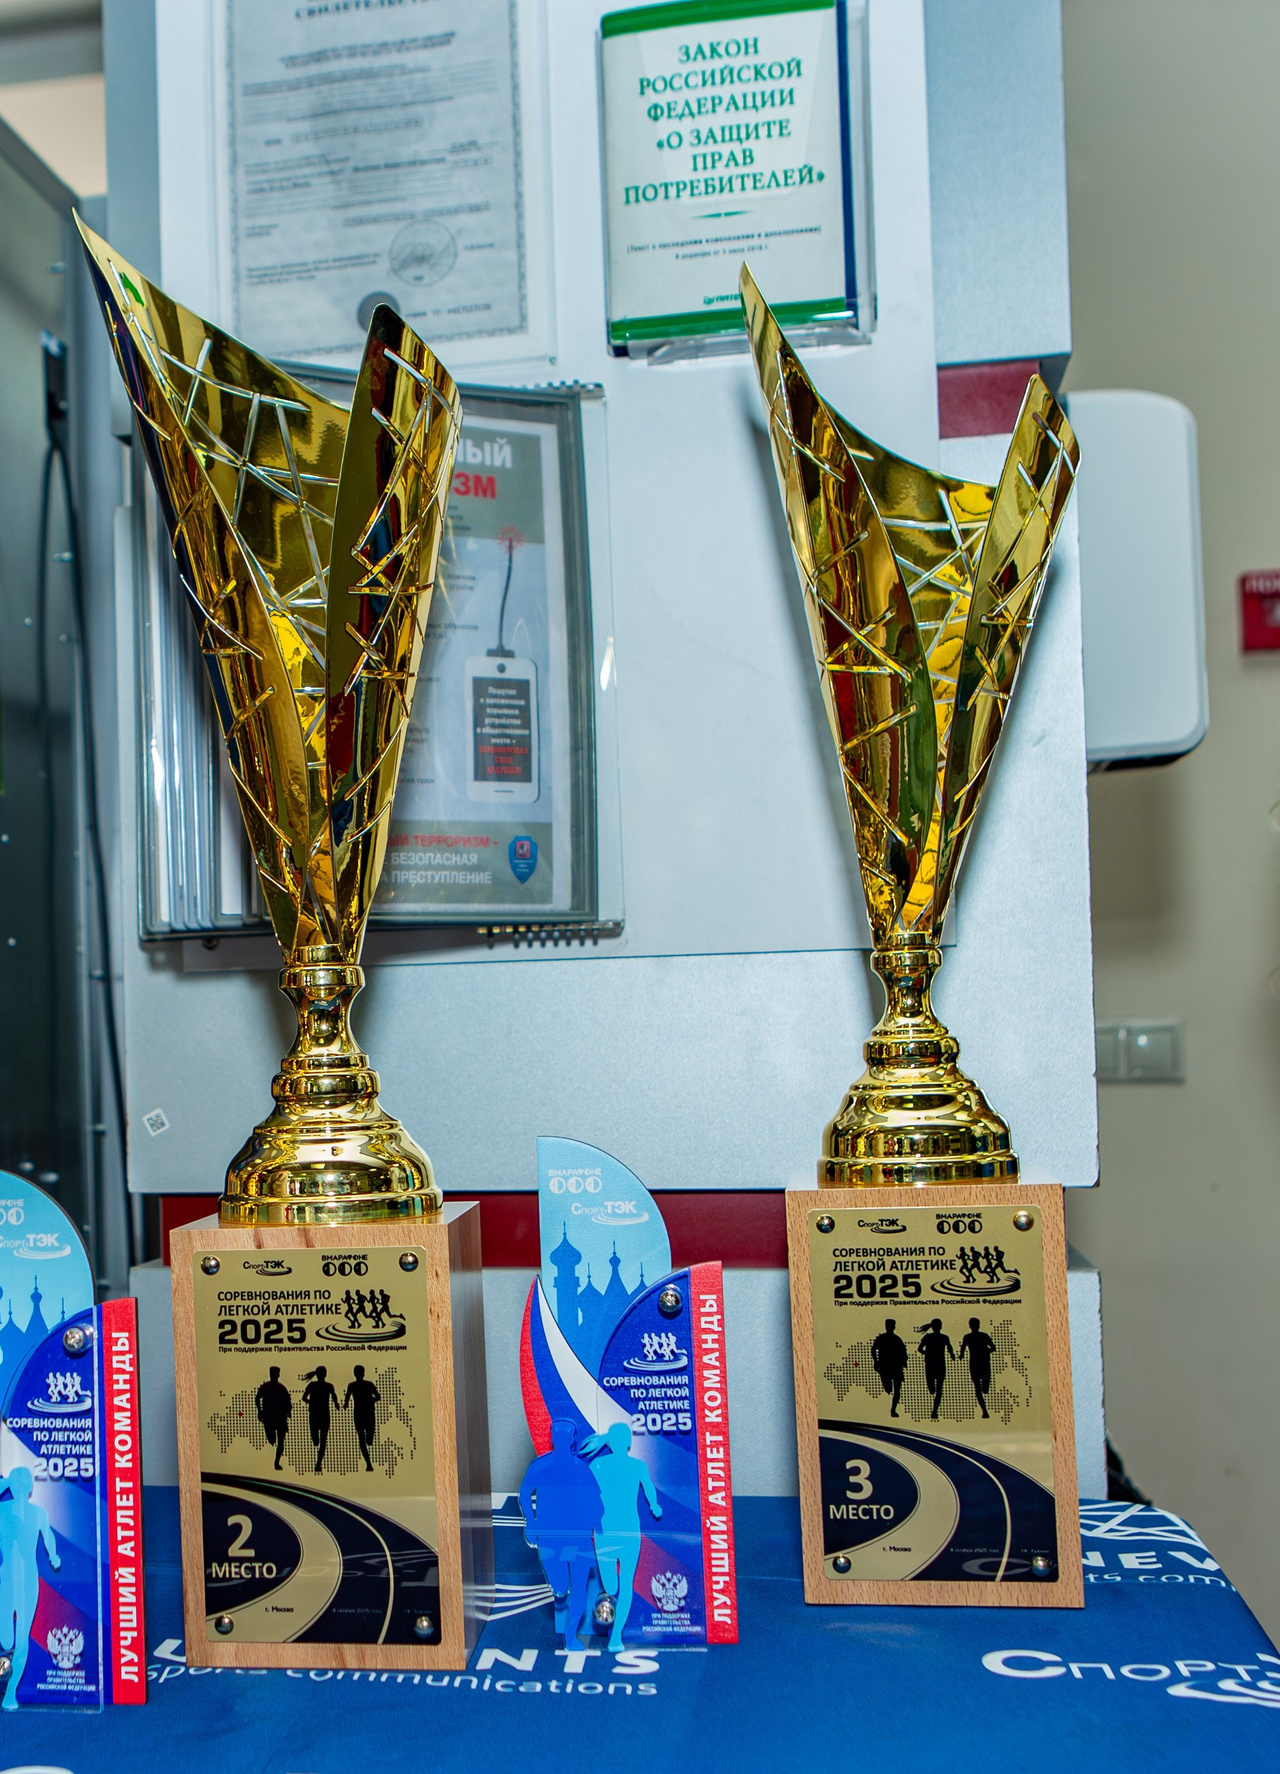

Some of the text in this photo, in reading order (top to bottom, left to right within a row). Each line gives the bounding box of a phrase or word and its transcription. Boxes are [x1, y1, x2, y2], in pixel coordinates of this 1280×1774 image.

[678, 36, 759, 63] ЗАКОН
[639, 57, 802, 96] РОССИЙСКОЙ
[647, 87, 795, 121] ФЕДЕРАЦИИ
[656, 118, 792, 150] «О ЗАЩИТЕ
[692, 148, 755, 172] ПРАВ
[623, 164, 825, 205] ПОТРЕБИТЕЛЕЙ»
[451, 471, 497, 500] ЗМ
[414, 834, 490, 848] ТЕРРОРИЗМ
[391, 853, 478, 866] БЕЗОПАСНАЯ
[391, 871, 492, 884] ПРЕСТУПЛЕНИЕ
[548, 1168, 602, 1177] ВМАРАФОНЕ
[936, 1212, 982, 1220] ВМАРАФОНЕ
[832, 1246, 946, 1258] СОРЕВНОВАНИЯ ПО
[833, 1258, 957, 1272] ЛЕГКОЙ АТЛЕТИКЕ
[834, 1274, 922, 1299] 2025
[217, 1289, 331, 1302] СОРЕВНОВАНИЯ ПО
[849, 1300, 888, 1308] поддержке
[889, 1299, 940, 1307] Правительства
[941, 1298, 981, 1306] Российской
[982, 1298, 1022, 1306] Федерации
[218, 1301, 342, 1317] ЛЕГКОЙ АТЛЕТИКЕ
[218, 1318, 307, 1345] 2025
[234, 1346, 272, 1354] поддержке
[274, 1345, 324, 1353] Правительства
[326, 1344, 366, 1352] Российской
[367, 1344, 408, 1353] Федерации
[603, 1375, 689, 1387] СОРЕВНОВАНИЯ
[630, 1386, 690, 1399] ПО ЛЕГКОЙ
[638, 1400, 690, 1411] АТЛЕТИКЕ
[7, 1417, 92, 1429] СОРЕВНОВАНИЯ
[631, 1413, 692, 1432] 2025
[33, 1429, 92, 1442] ПО ЛЕГКОЙ
[40, 1444, 93, 1455] АТЛЕТИКЕ
[33, 1457, 95, 1478] 2025
[699, 1294, 732, 1625] ЛУЧШИЙ АТЛЕТ КОМАНДЫ
[845, 1458, 874, 1501] 3
[112, 1332, 139, 1684] ЛУЧШИЙ АТЛЕТ КОМАНДЫ
[829, 1504, 895, 1520] МЕСТО
[226, 1514, 255, 1557] 2
[211, 1562, 277, 1580] МЕСТО
